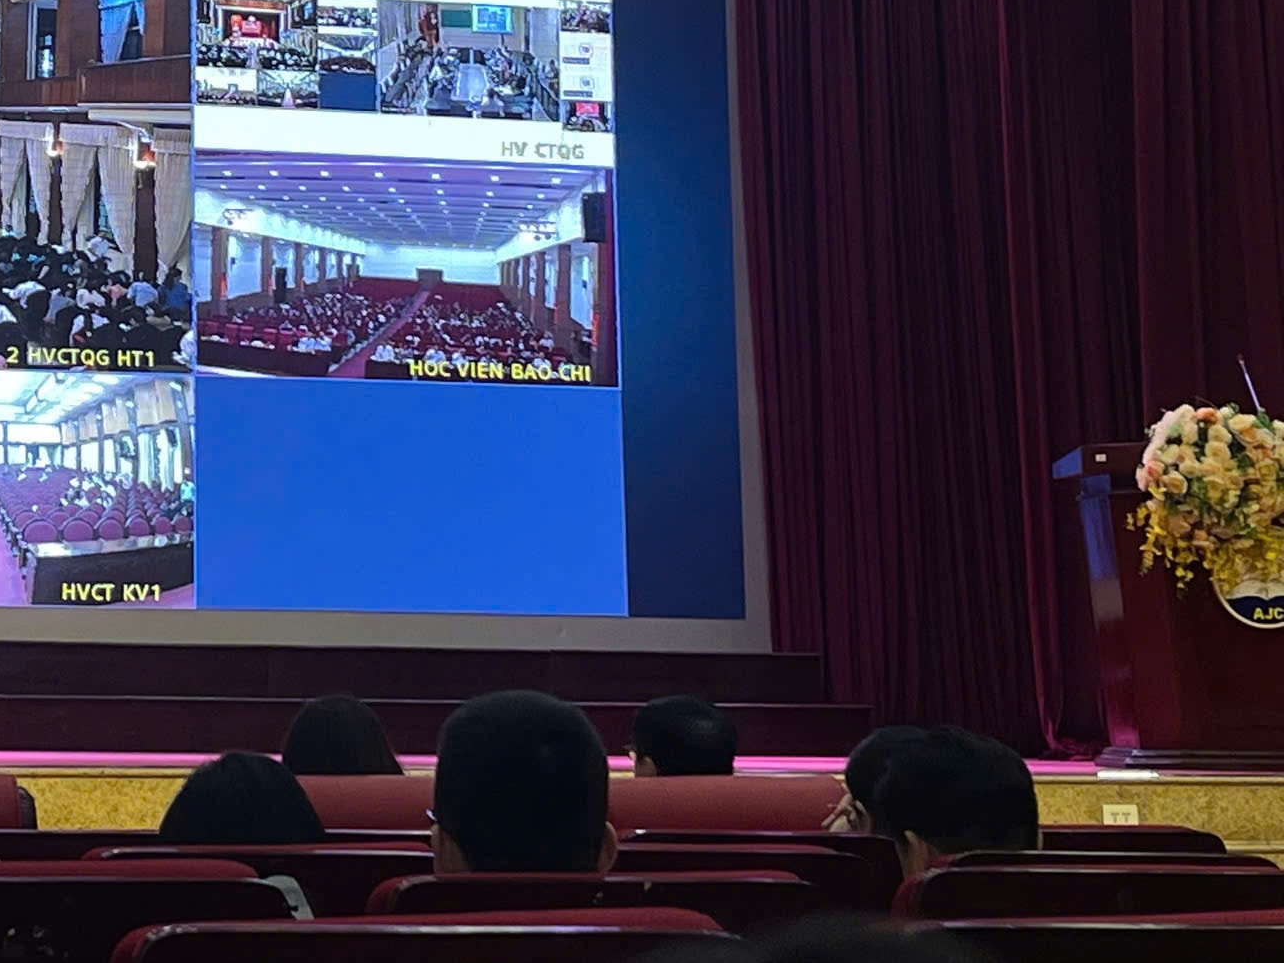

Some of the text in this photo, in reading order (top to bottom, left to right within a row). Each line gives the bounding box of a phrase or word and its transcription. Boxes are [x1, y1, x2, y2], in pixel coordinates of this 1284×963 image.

[501, 141, 528, 157] HV
[6, 346, 154, 367] 2 HVCTQG HT1
[409, 359, 591, 382] HOC VIEN BAO CHI
[61, 582, 160, 602] HVCT KV1
